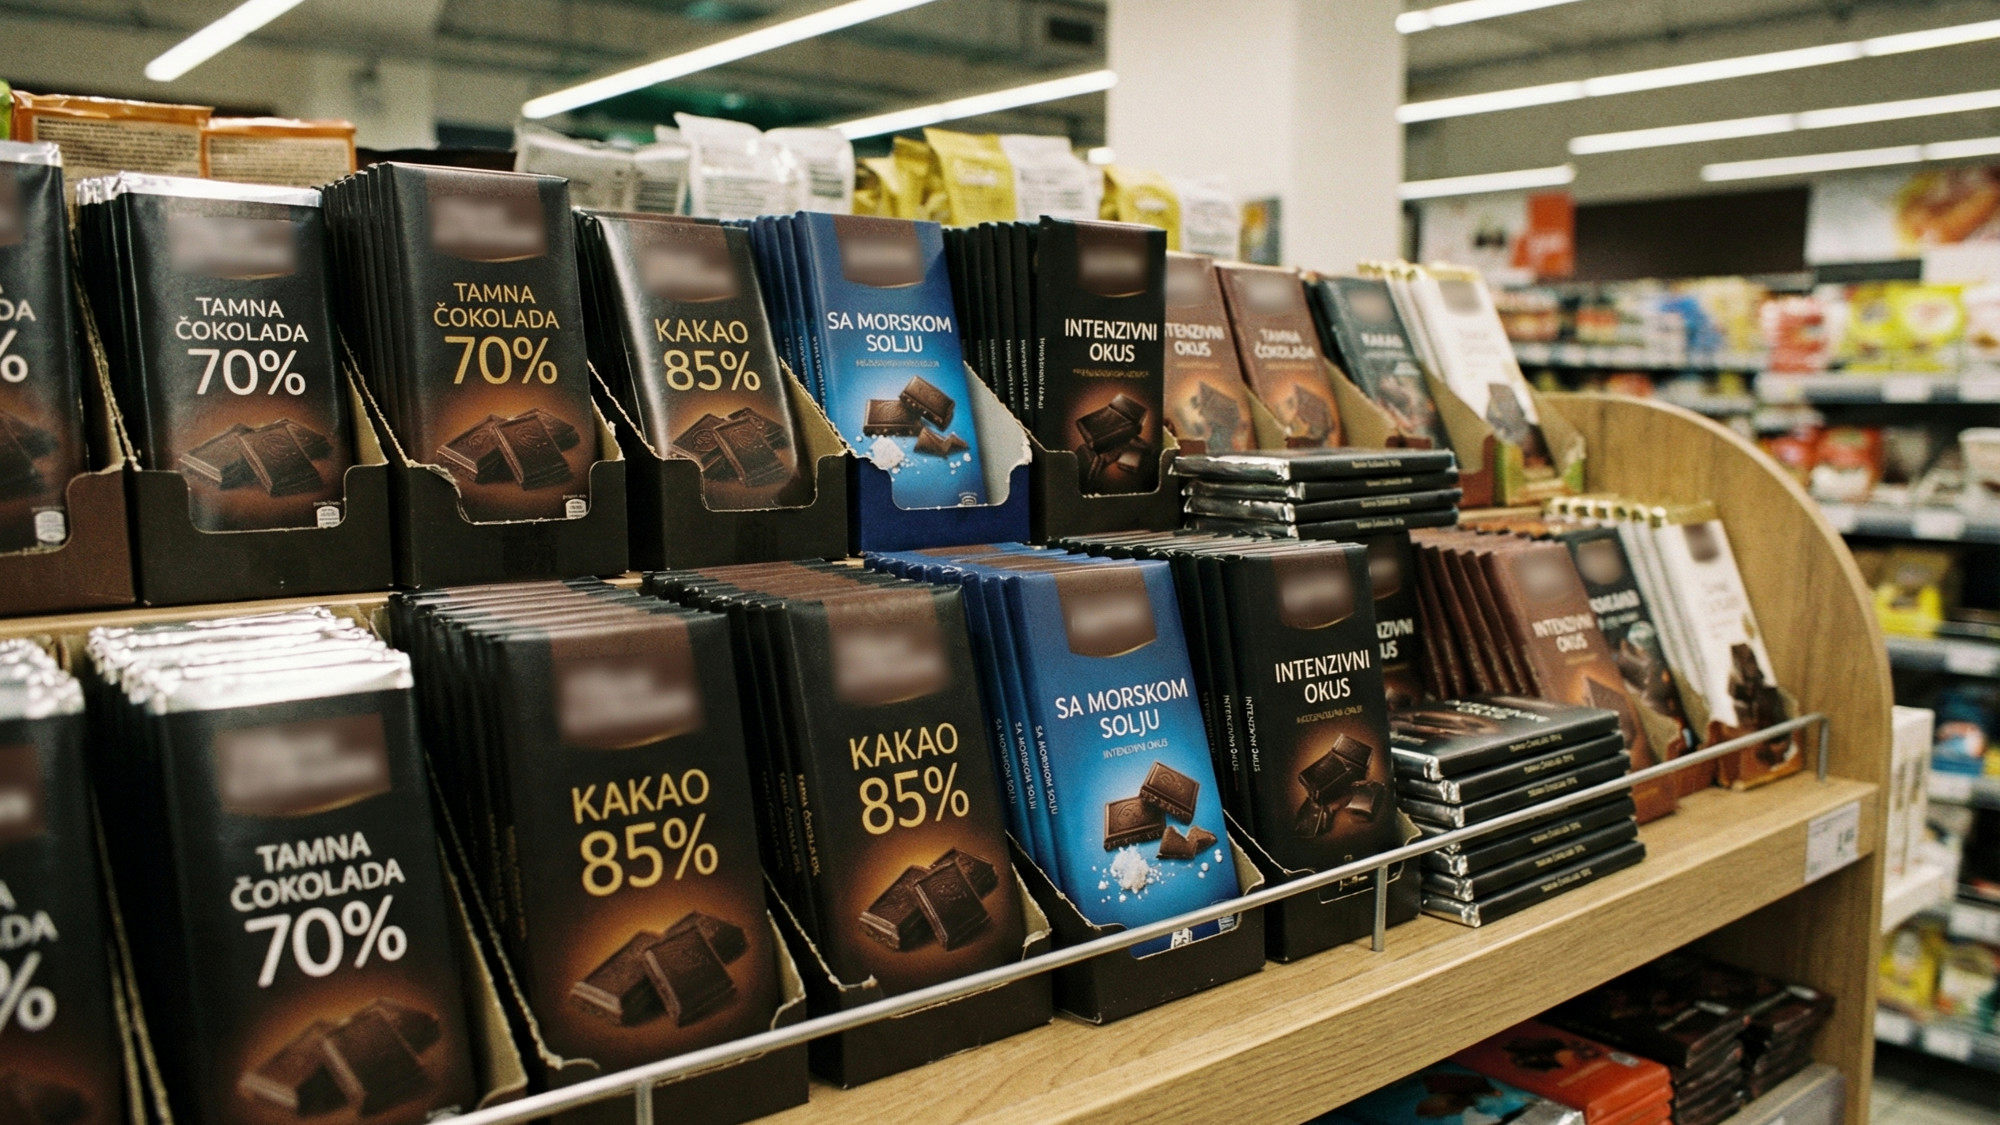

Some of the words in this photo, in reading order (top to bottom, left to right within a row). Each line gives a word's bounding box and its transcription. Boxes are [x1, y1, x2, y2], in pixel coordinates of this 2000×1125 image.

[194, 296, 285, 319] TAMNA
[453, 282, 536, 304] TAMNA
[174, 311, 309, 343] ČOKOLADA
[433, 298, 560, 330] ČOKOLADA
[827, 311, 854, 330] SA
[857, 312, 952, 334] MORSKOM
[1065, 318, 1158, 341] INTENZIVNI
[654, 317, 749, 345] KAKAO
[865, 333, 923, 353] SOLJU
[1166, 322, 1225, 341] TENZIVNI
[444, 335, 558, 385] 70%
[1089, 342, 1135, 363] OKUS
[1174, 339, 1212, 358] OKUS
[187, 347, 306, 396] 70%
[664, 349, 762, 393] 85%
[1378, 639, 1399, 660] US
[1274, 649, 1372, 685] INTENZIVNI
[1055, 694, 1084, 720] SA
[1087, 677, 1189, 715] MORSKOM
[1303, 676, 1352, 705] OKUS
[1099, 708, 1160, 740] SOLJU
[849, 721, 959, 771] KAKAO
[572, 768, 710, 825] KAKAO
[858, 761, 970, 836] 85%
[256, 830, 372, 873] TAMNA
[580, 812, 719, 897] 85%
[229, 857, 406, 914] ČOKOLADA
[244, 894, 407, 988] 70%
